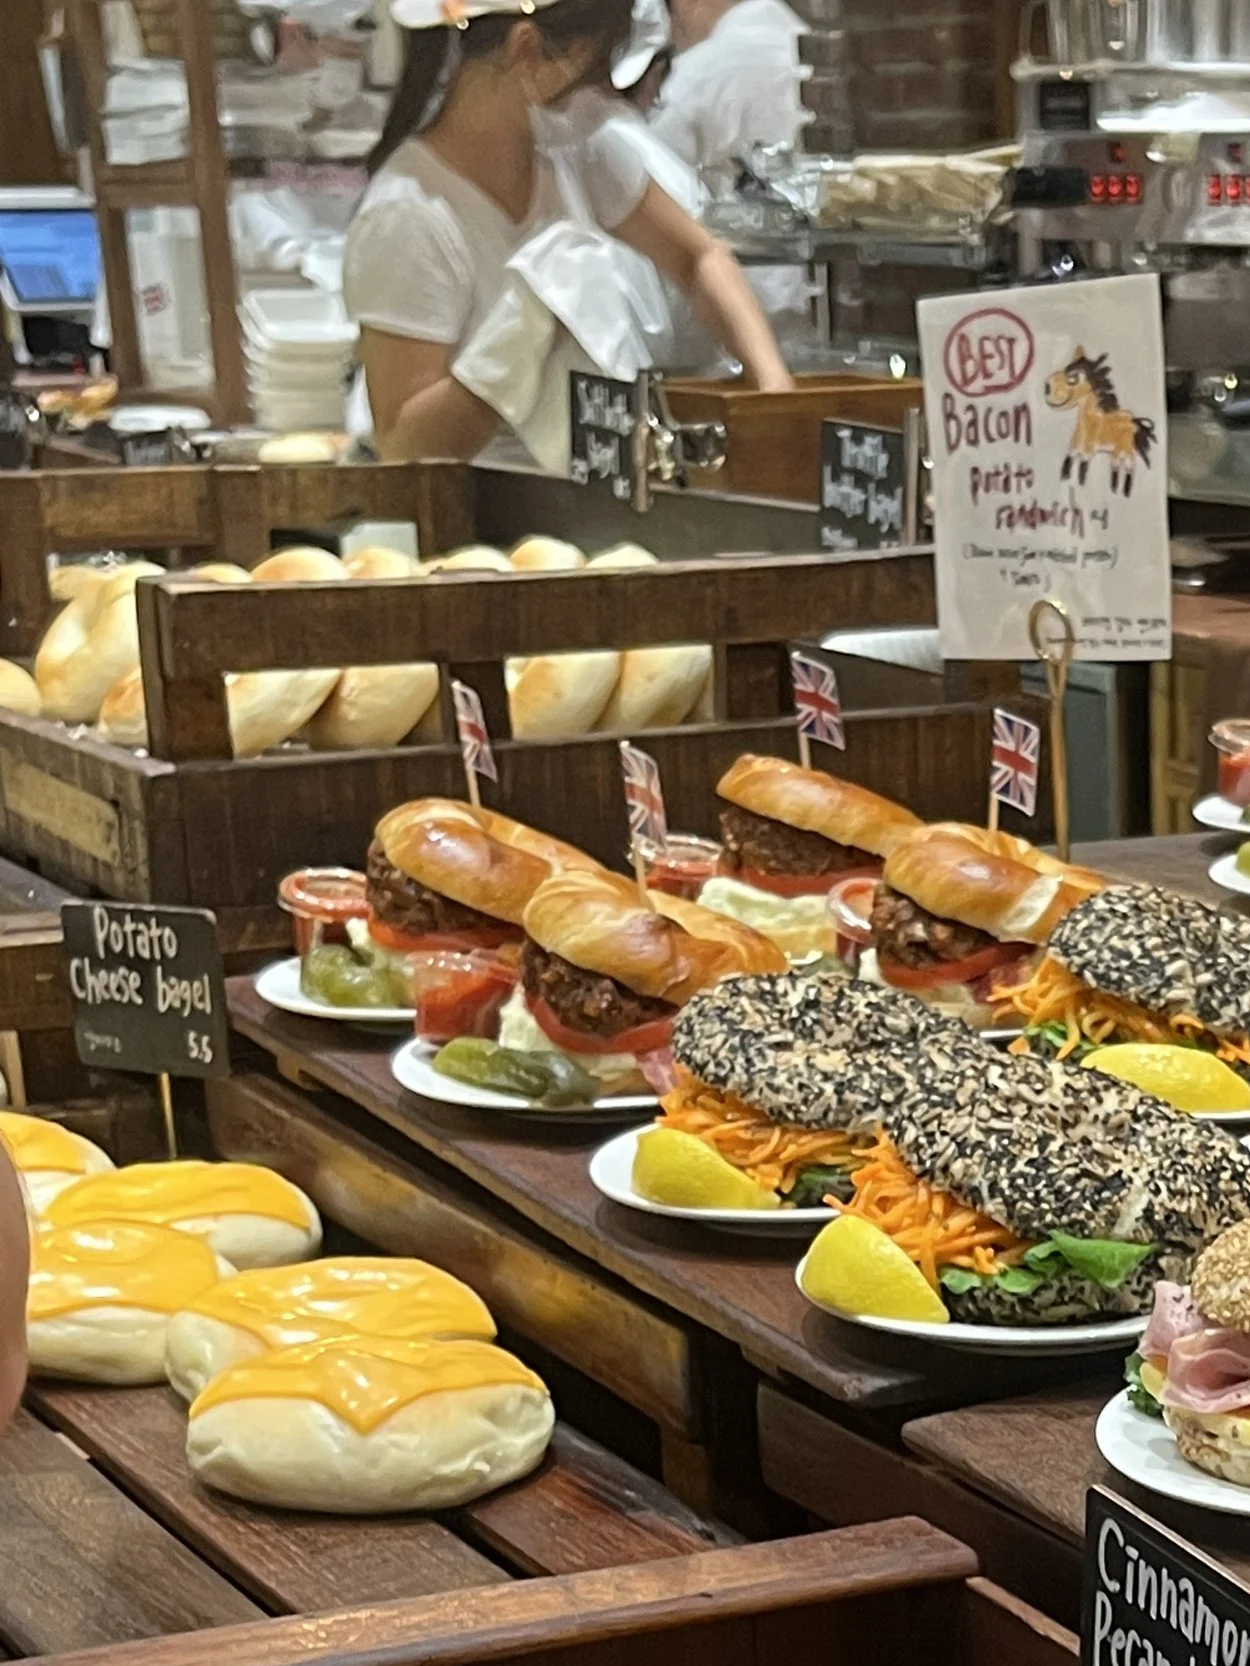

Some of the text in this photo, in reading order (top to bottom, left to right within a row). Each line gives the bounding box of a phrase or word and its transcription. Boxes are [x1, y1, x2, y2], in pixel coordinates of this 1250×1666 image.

[956, 332, 1020, 389] BEST
[940, 392, 1034, 456] Bacon
[92, 904, 178, 961] Potato
[69, 956, 213, 1018] Cheese bagel
